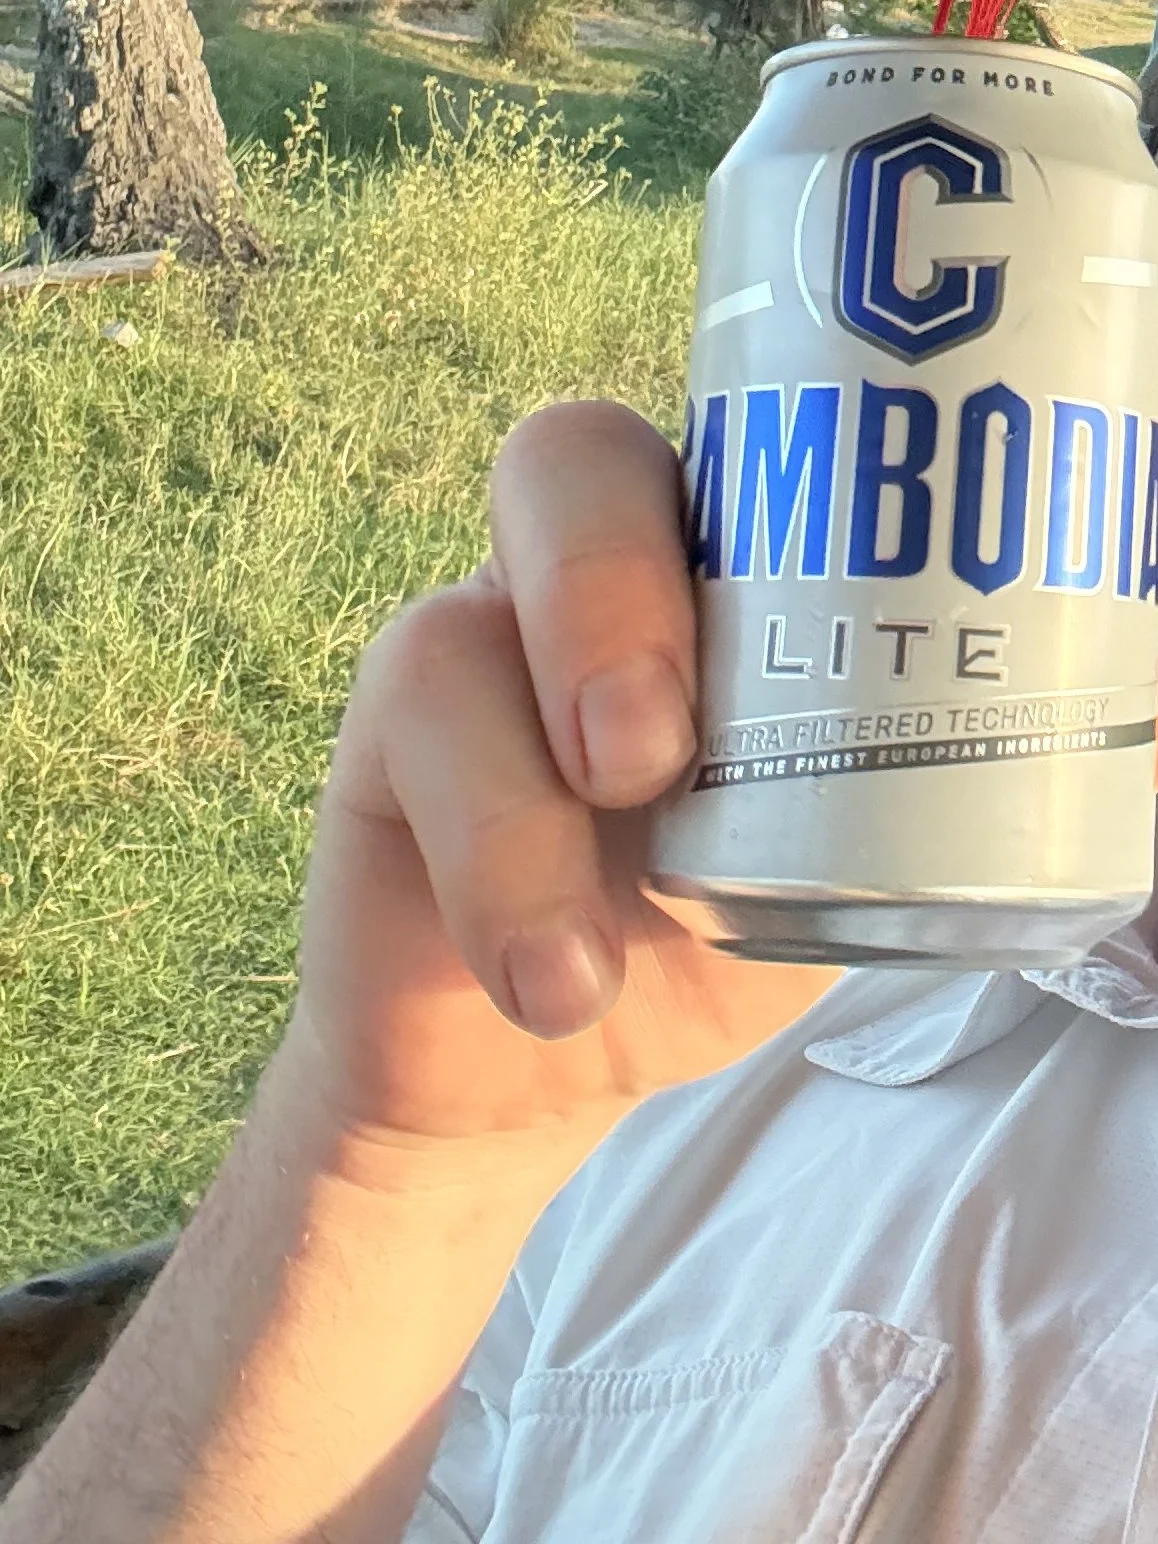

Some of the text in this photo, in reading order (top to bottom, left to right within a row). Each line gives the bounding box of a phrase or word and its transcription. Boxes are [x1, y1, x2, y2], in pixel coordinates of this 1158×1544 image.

[826, 66, 1055, 96] BOND FOR MORE
[762, 614, 1012, 687] LITE
[794, 711, 933, 750] FILTERED
[948, 696, 1110, 732] TECHNOLOGY
[752, 759, 786, 778] THE
[795, 752, 867, 773] FINEST
[878, 741, 986, 764] EUROPEAN
[996, 731, 1107, 756] INGREDIENTS
